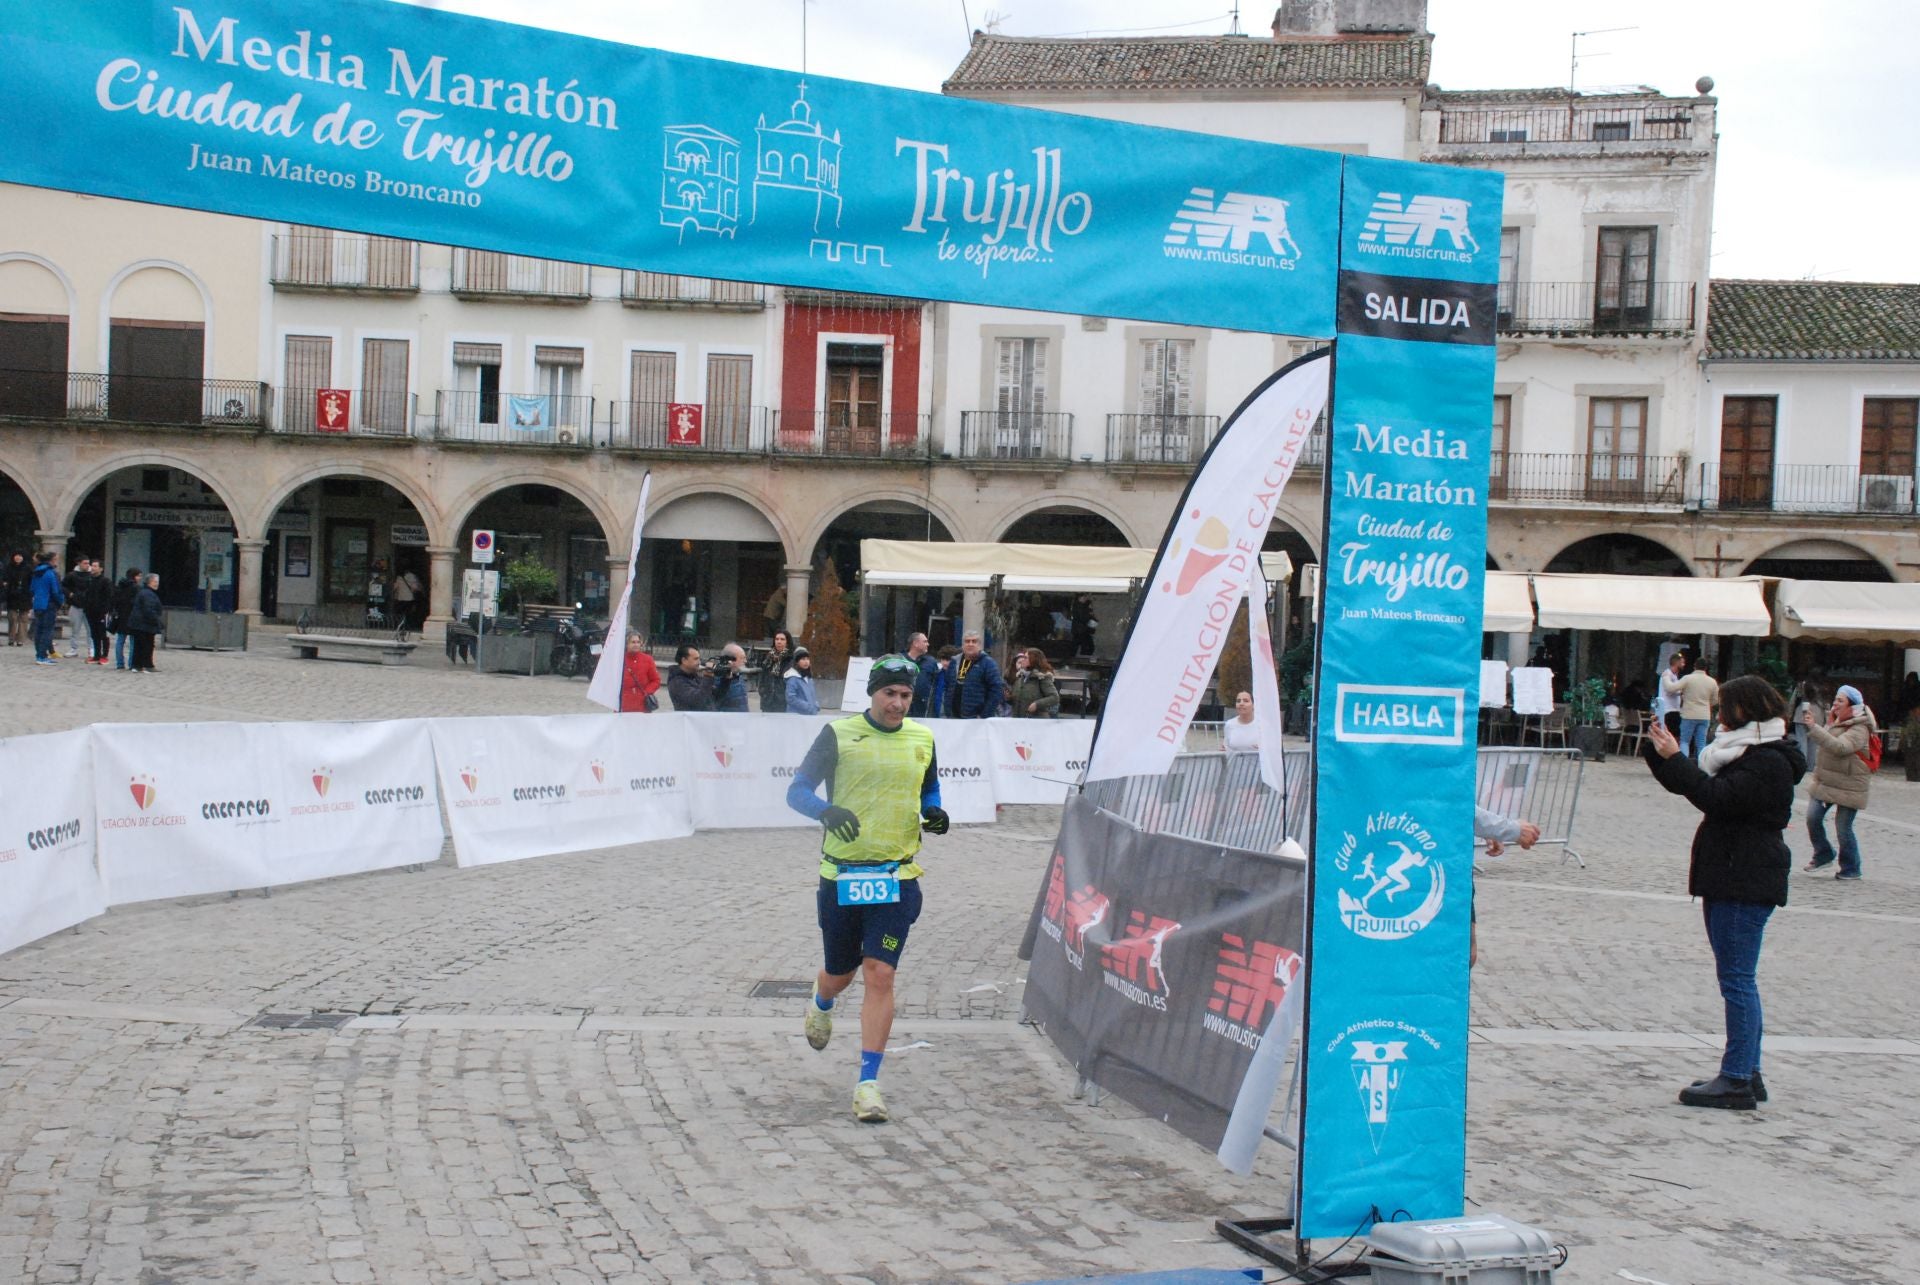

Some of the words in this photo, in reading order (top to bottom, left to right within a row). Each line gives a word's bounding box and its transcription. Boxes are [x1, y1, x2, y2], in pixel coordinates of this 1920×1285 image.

[172, 7, 367, 90] Media
[386, 48, 619, 130] Maratón
[96, 58, 303, 138] Ciudad
[313, 102, 385, 150] de
[397, 109, 574, 188] Trujillo
[187, 143, 252, 174] Juan
[261, 154, 356, 190] Mateos
[365, 170, 482, 209] Broncano
[895, 136, 1092, 252] Trujillo
[938, 228, 961, 261] te
[1163, 244, 1296, 271] www.musicrun.es
[1358, 241, 1473, 264] www.musicrun.es
[1364, 292, 1471, 328] SALIDA
[1352, 423, 1469, 460] Media
[1344, 471, 1477, 506] Maratón
[1357, 513, 1425, 540] Ciudad
[1427, 521, 1453, 541] de
[1339, 542, 1469, 602] Trujillo
[1341, 606, 1368, 620] Juan
[1371, 607, 1412, 620] Mateos
[1414, 609, 1466, 625] Broncano
[1156, 579, 1239, 745] DIPUTACIÓN
[1228, 537, 1255, 574] DE
[1353, 702, 1444, 728] HABLA
[1334, 831, 1357, 872] Club
[1366, 811, 1437, 850] Atletismo
[848, 880, 889, 902] 503
[1344, 910, 1421, 933] TRUJILLO
[1103, 970, 1168, 1012] www.musicrun.es
[1202, 1011, 1263, 1051] www.musicr
[1327, 1031, 1346, 1053] Club
[1397, 1020, 1418, 1035] San
[1359, 1069, 1370, 1090] A
[1388, 1069, 1398, 1090] J
[1374, 1091, 1384, 1111] S
